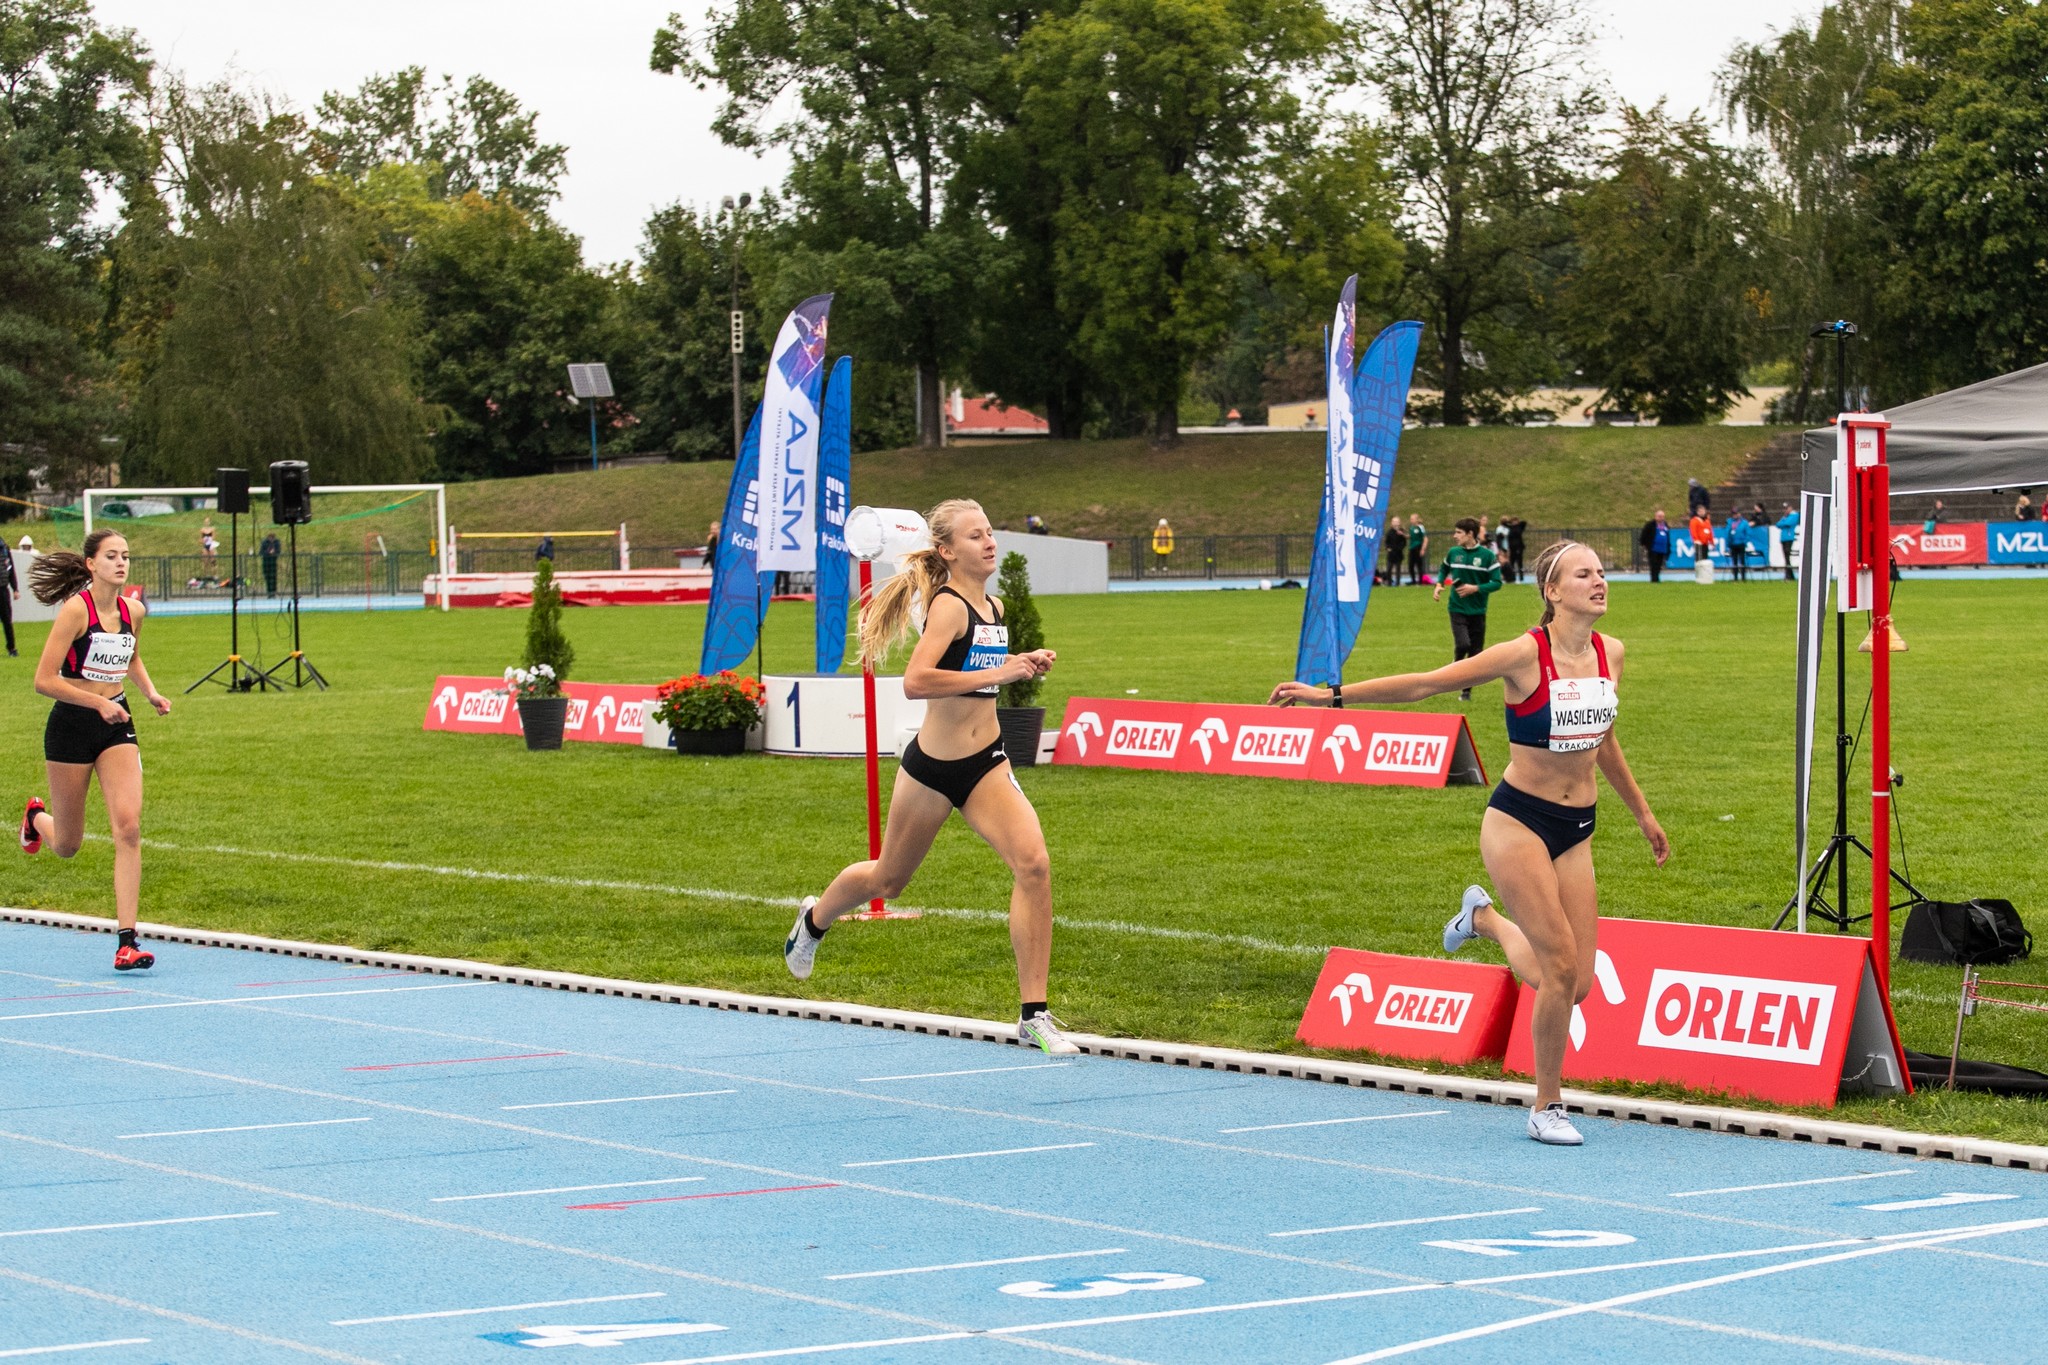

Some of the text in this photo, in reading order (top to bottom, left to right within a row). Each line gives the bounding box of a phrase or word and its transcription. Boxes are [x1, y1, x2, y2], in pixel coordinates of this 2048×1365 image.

[1924, 537, 1962, 549] ORLEN
[122, 636, 131, 647] 31
[92, 653, 128, 665] MUCHA
[463, 698, 503, 718] ORLEN
[621, 707, 643, 727] ORL
[787, 681, 801, 748] 1
[1113, 726, 1176, 752] ORLEN
[1239, 732, 1306, 758] ORLEN
[1558, 740, 1595, 750] KRAKÓW
[1372, 739, 1441, 767] ORLEN
[1384, 991, 1464, 1026] ORLEN
[1654, 982, 1821, 1051] ORLEN
